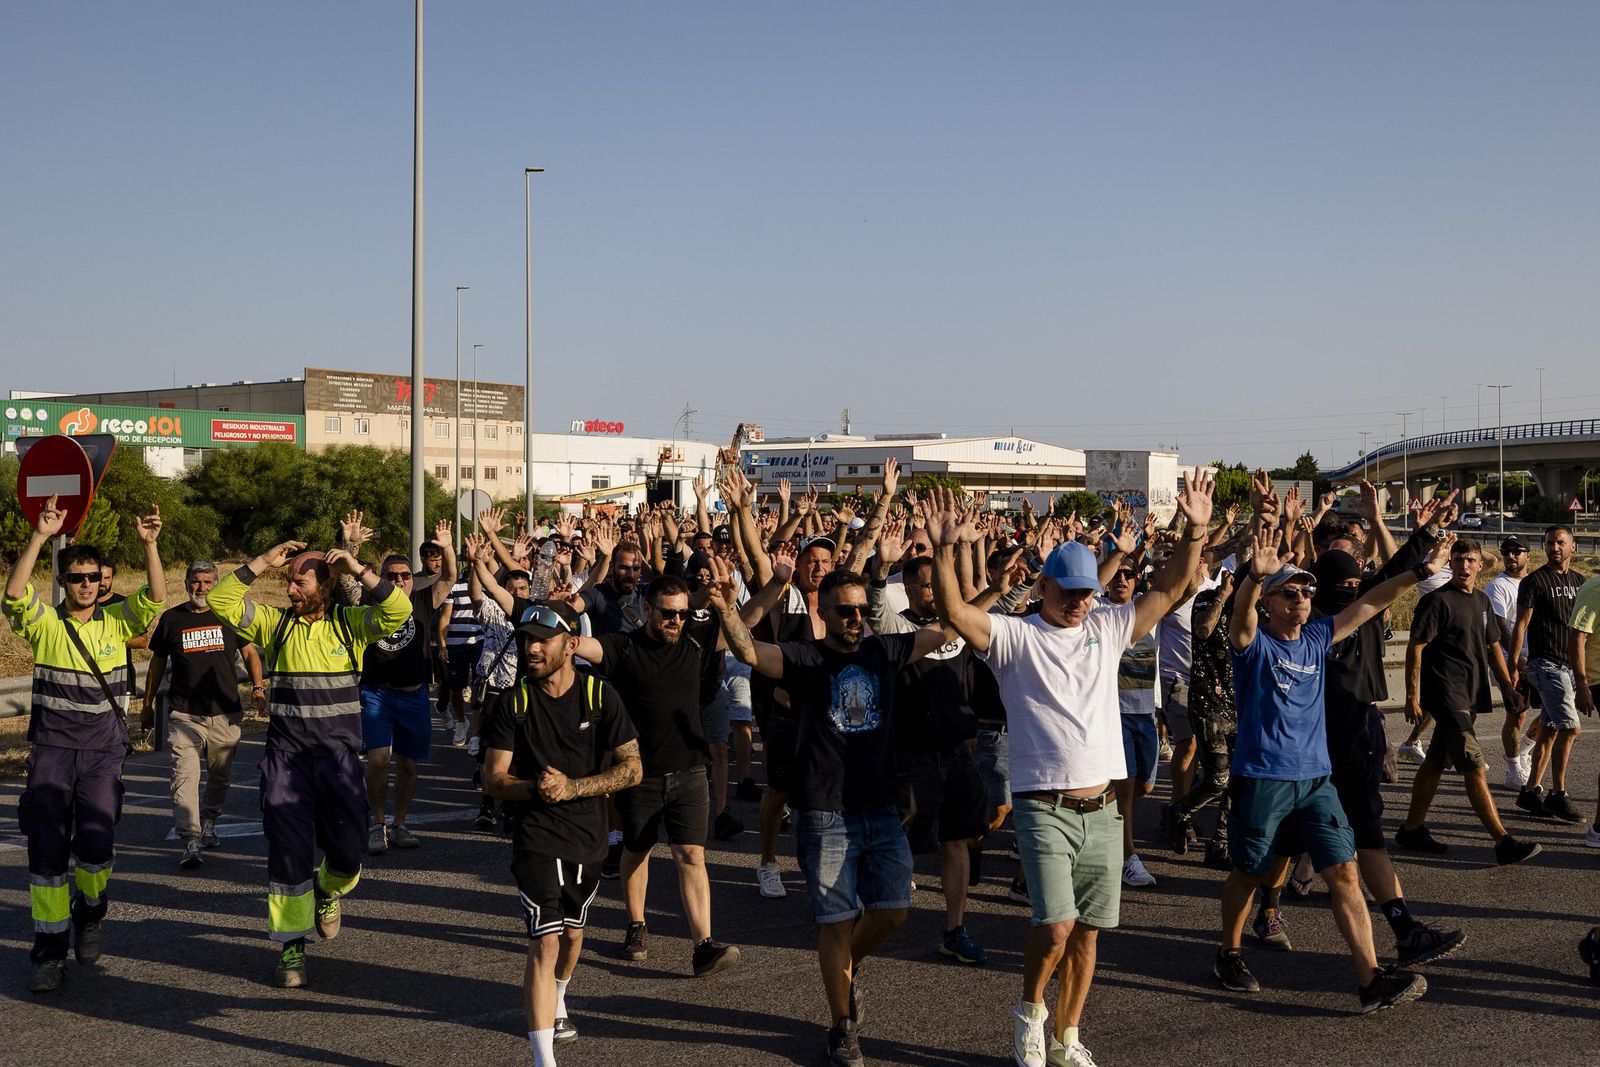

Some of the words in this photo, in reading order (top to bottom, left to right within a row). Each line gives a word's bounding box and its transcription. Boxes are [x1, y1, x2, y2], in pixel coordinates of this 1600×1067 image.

[250, 424, 286, 432] INDUSTRIALES
[571, 418, 624, 434] mateco
[1551, 586, 1580, 598] ICON
